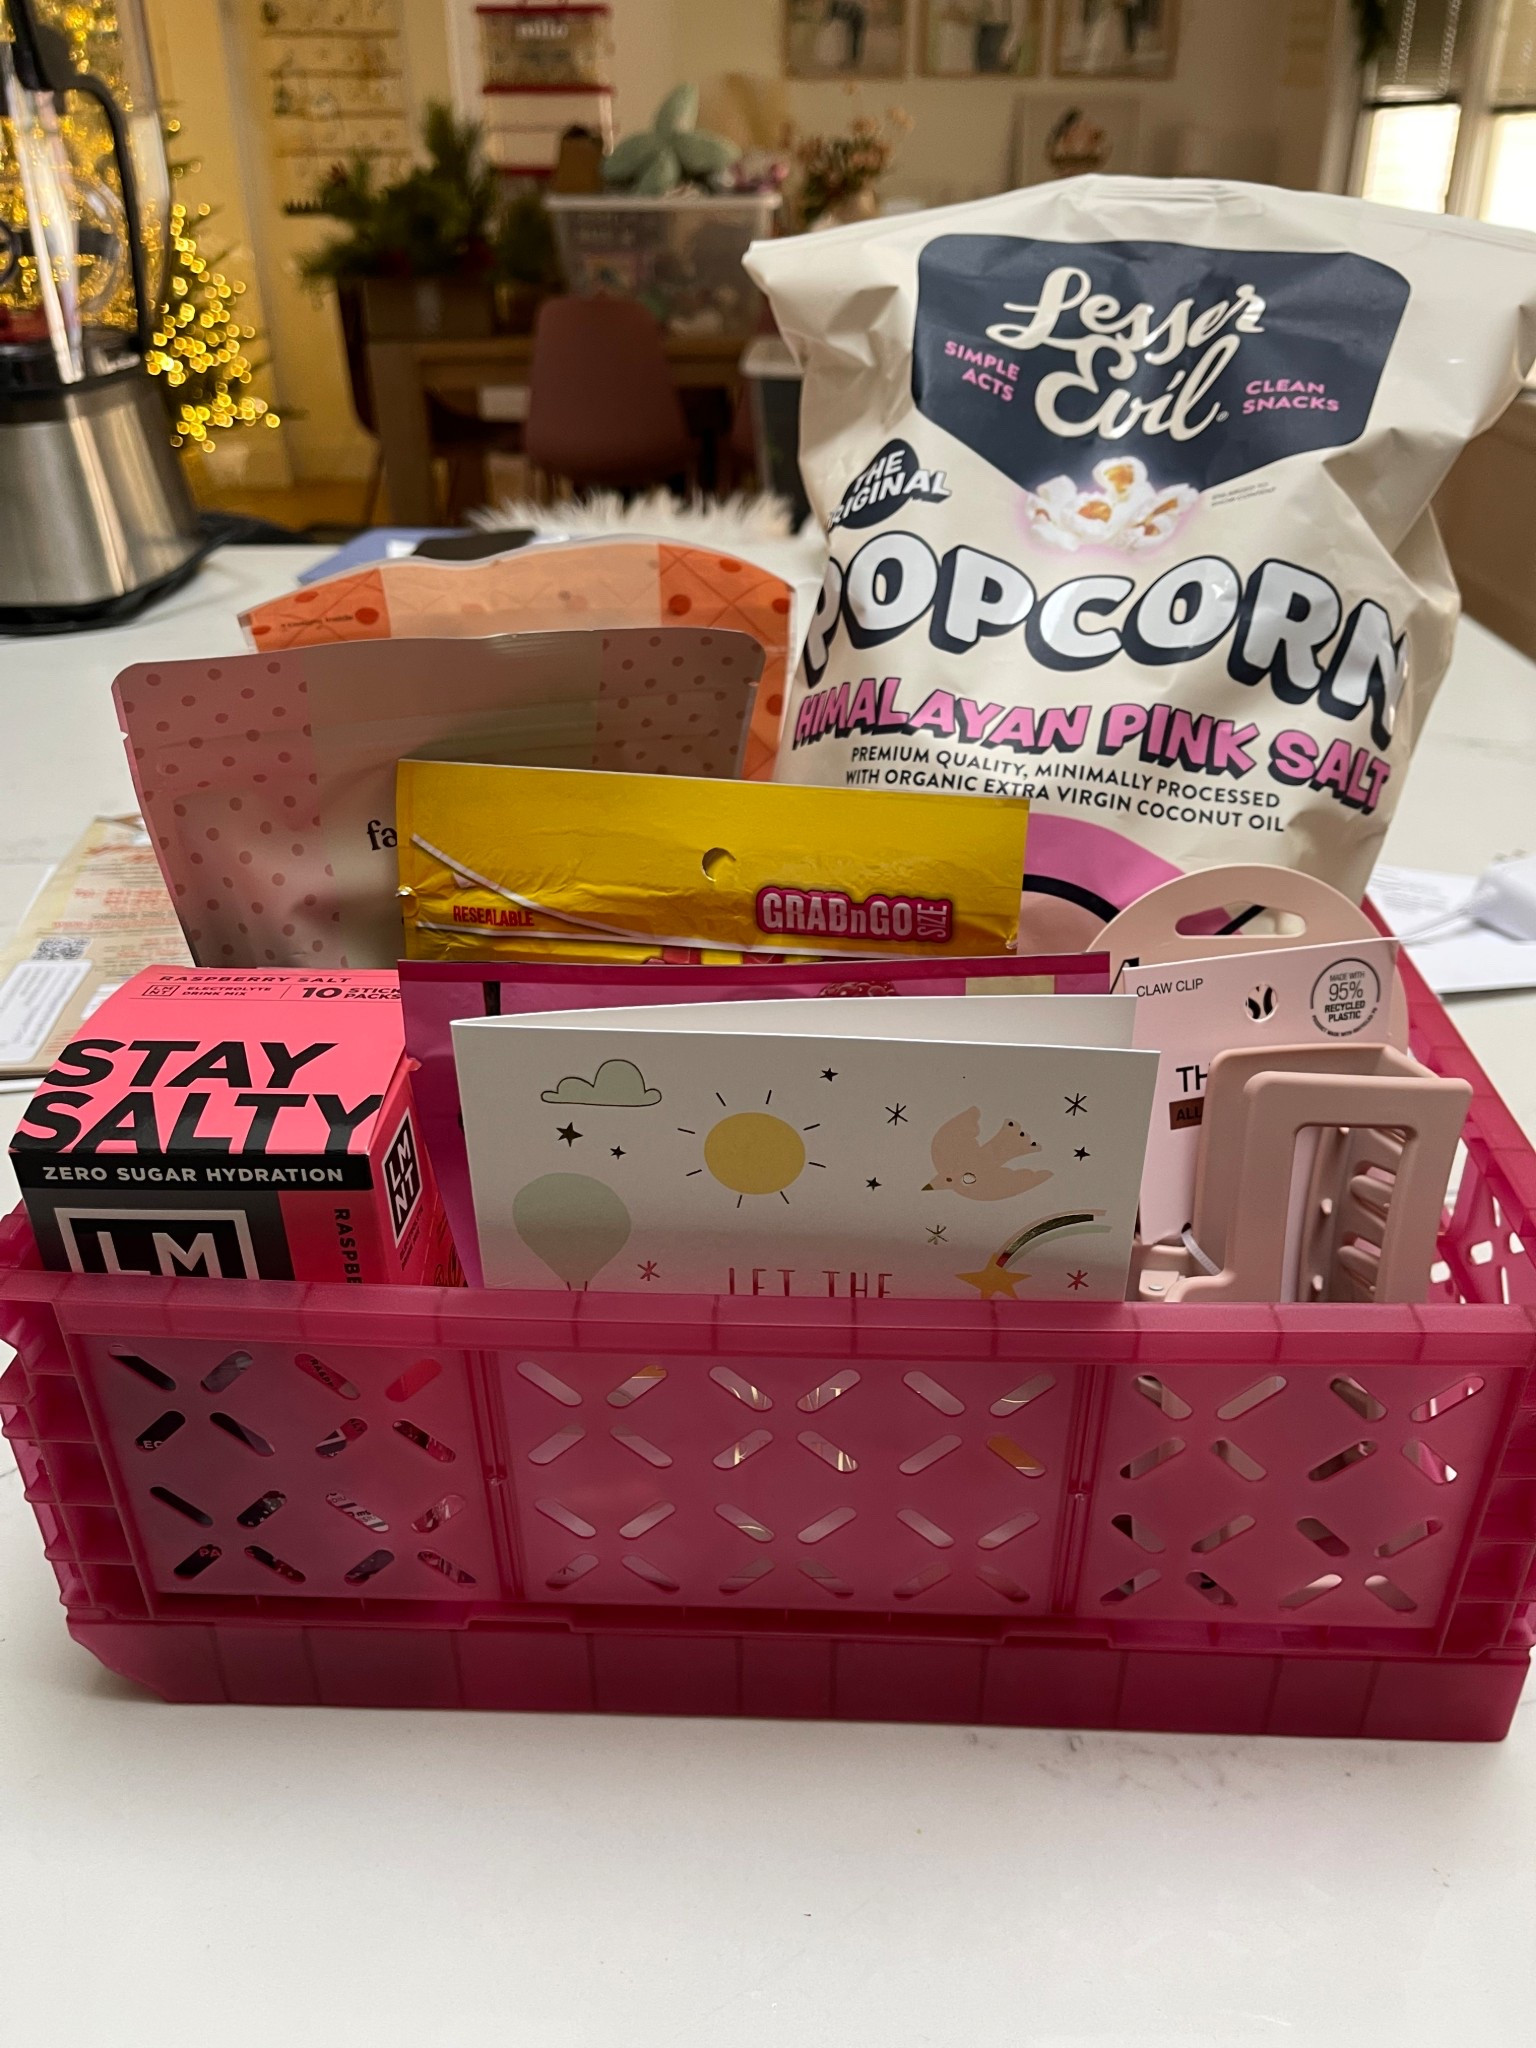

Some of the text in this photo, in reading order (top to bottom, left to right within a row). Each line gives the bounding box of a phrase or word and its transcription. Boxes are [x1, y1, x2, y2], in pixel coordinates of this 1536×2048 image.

[985, 267, 1267, 366] Lesser
[945, 341, 1019, 381] SIMPLE
[962, 369, 1014, 401] ACTS
[1035, 334, 1240, 441] Evil
[1245, 379, 1325, 395] CLEAN
[1242, 396, 1340, 414] SNACKS
[853, 450, 905, 493] THE
[803, 530, 1407, 750] POPCORN
[793, 677, 1391, 815] HIMALAYAN PINK SALT
[851, 746, 1280, 808] PREMIUM QUALITY, MINIMALLY PROCESSED
[846, 769, 1284, 832] WITH ORGANIC EXTRA VIRGIN COCONUT OIL
[453, 905, 535, 927] RESEALABLE
[763, 893, 947, 938] GRABnGO SIZE
[302, 987, 342, 998] 10
[1137, 978, 1203, 997] CLAW CLIP
[1329, 980, 1363, 1001] 95%
[1330, 971, 1365, 981] MADE WITH
[1325, 1000, 1366, 1013] RECYCLED
[1328, 1011, 1361, 1023] PLASTIC
[44, 1039, 339, 1088] STAY
[9, 1091, 384, 1154] SALTY
[43, 1166, 343, 1183] ZERO SUGAR HYDRATION
